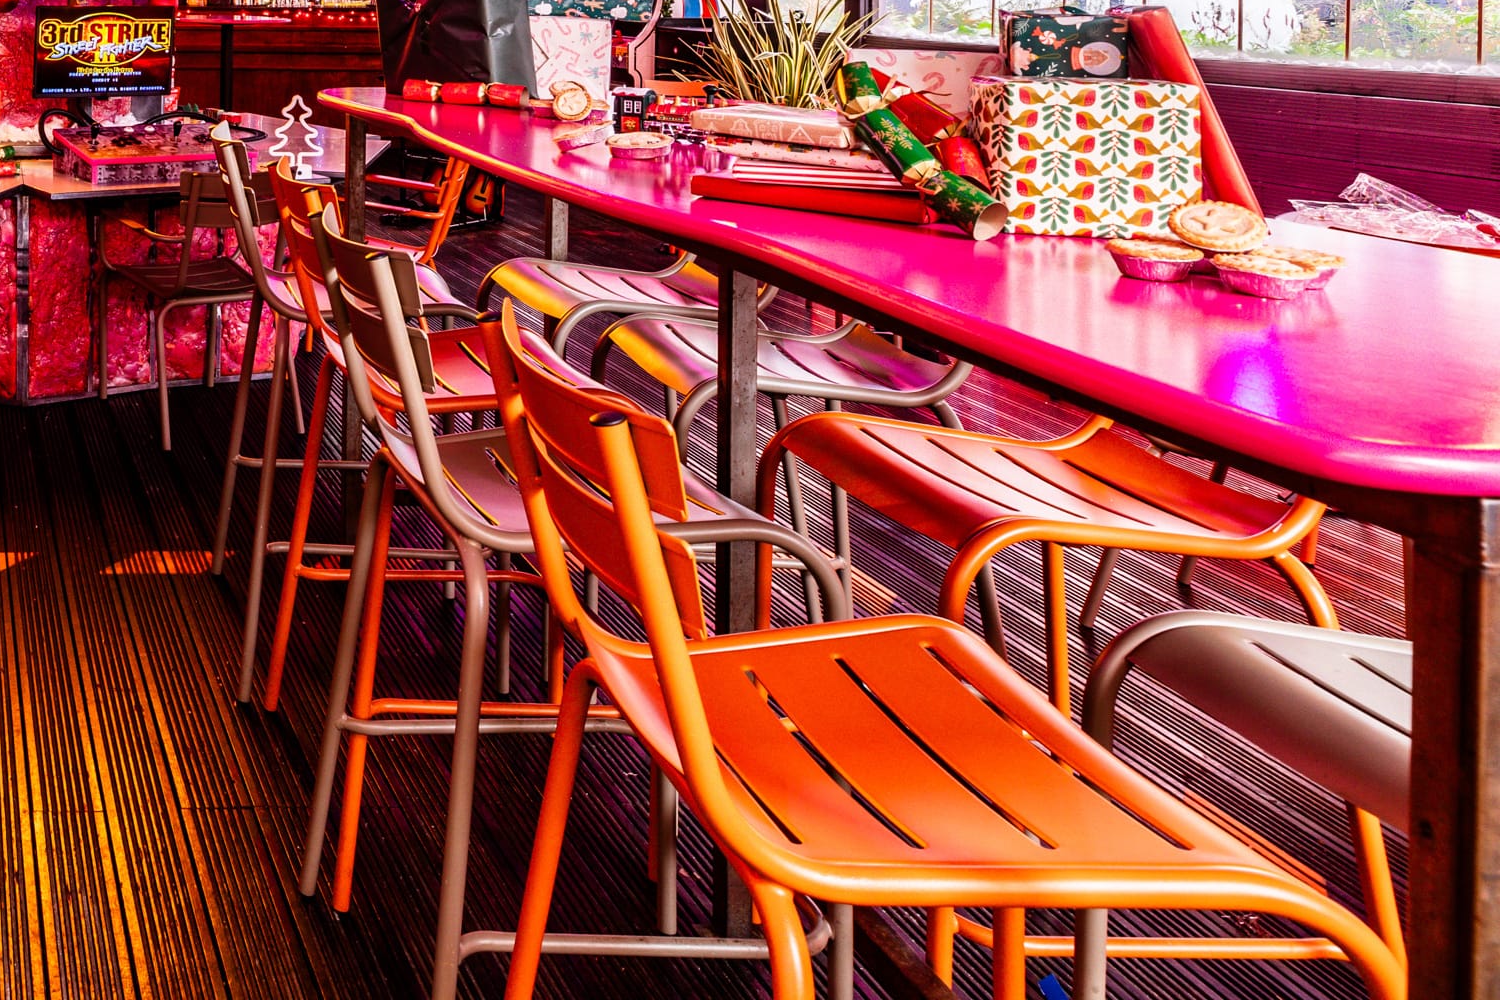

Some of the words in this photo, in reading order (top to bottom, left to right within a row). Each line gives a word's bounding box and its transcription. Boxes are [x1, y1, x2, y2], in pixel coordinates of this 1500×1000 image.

[42, 23, 84, 44] 3rd
[89, 22, 168, 44] STRIKE
[51, 36, 101, 58] STREET
[100, 36, 163, 58] FIGHTER
